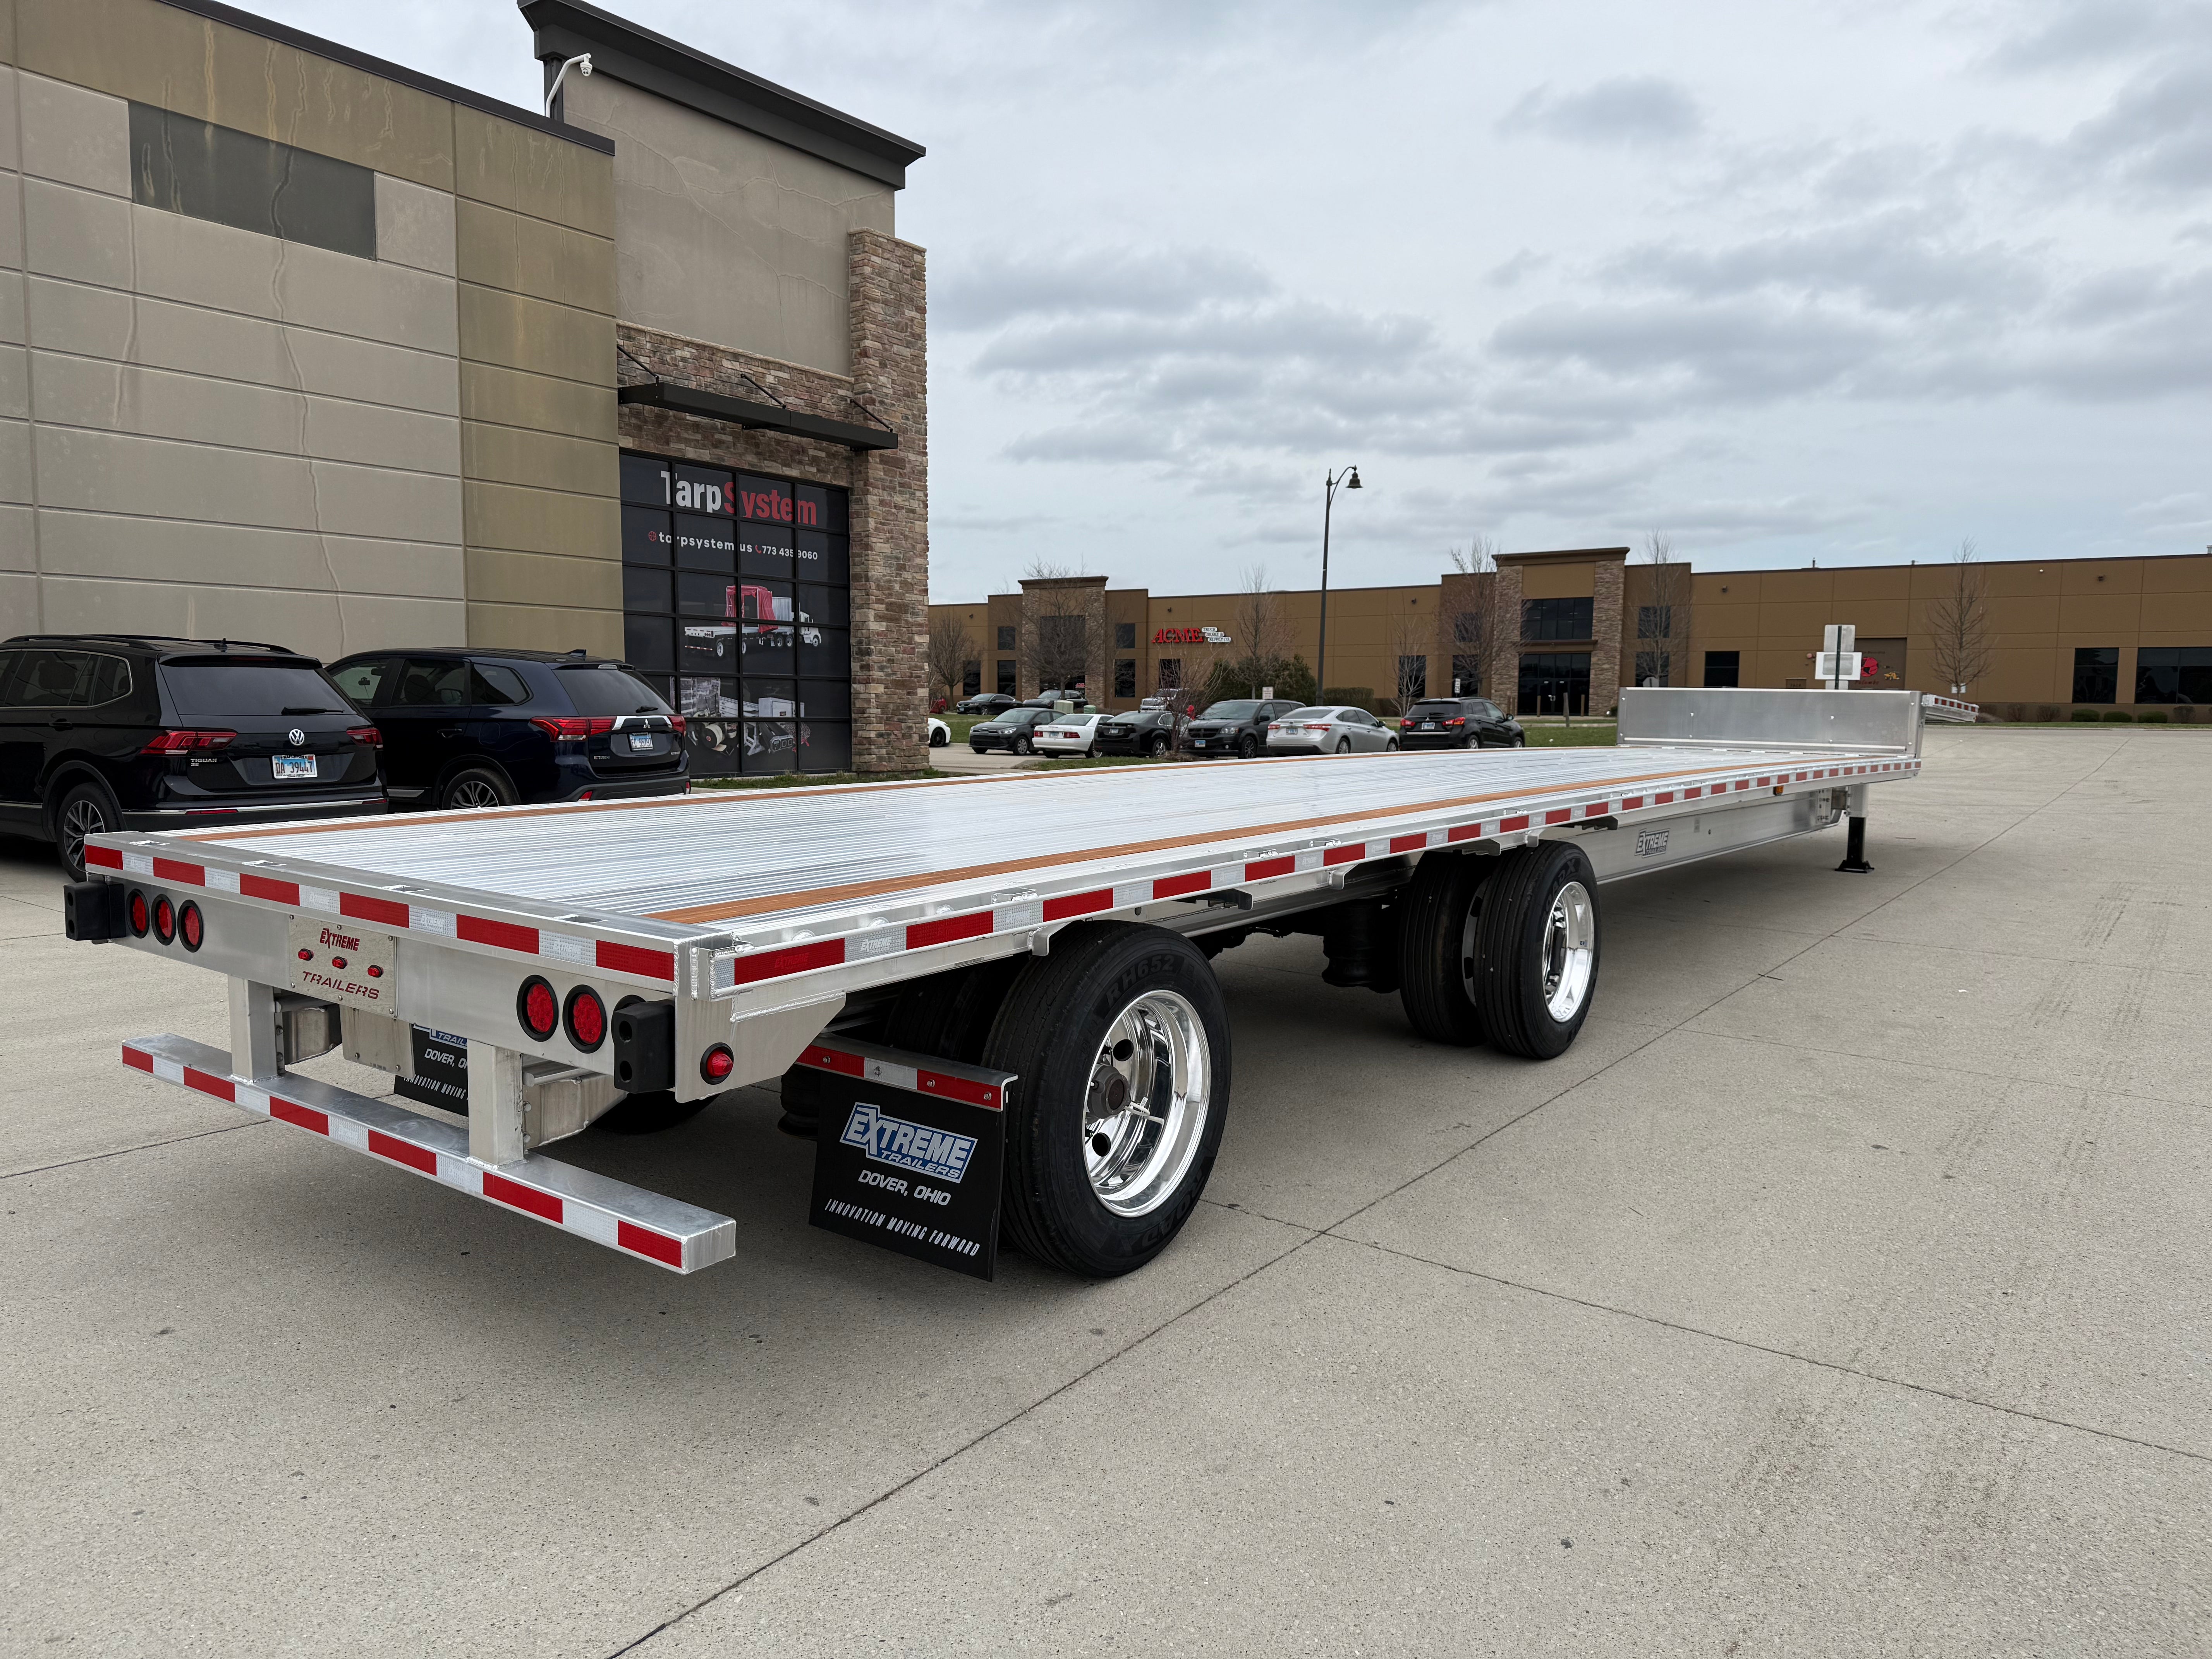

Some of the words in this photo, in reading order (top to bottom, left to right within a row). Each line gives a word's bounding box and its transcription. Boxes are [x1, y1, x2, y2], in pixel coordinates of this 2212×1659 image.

[762, 545, 776, 555] 773
[779, 548, 793, 558] 435
[798, 550, 818, 560] 9060
[1151, 628, 1204, 643] ACME
[275, 762, 285, 773] DA
[289, 761, 313, 773] 39447
[1637, 831, 1669, 855] EXTREME
[320, 928, 360, 951] EXTREME
[553, 939, 582, 955] EXTREME
[860, 936, 891, 952] EXTREME
[303, 971, 380, 1000] TRAILERS
[1106, 954, 1174, 1008] RH652
[438, 1032, 467, 1046] TRAIL
[424, 1048, 455, 1067] DOVER,
[441, 1083, 466, 1099] MOVING
[846, 1107, 972, 1169] EXTREME
[881, 1150, 961, 1178] TRAILERS
[858, 1170, 908, 1196] DOVER,
[914, 1185, 951, 1206] OHIO
[824, 1199, 886, 1227] INNOVATION
[886, 1217, 927, 1240] MOVING
[929, 1230, 980, 1256] FORWARD
